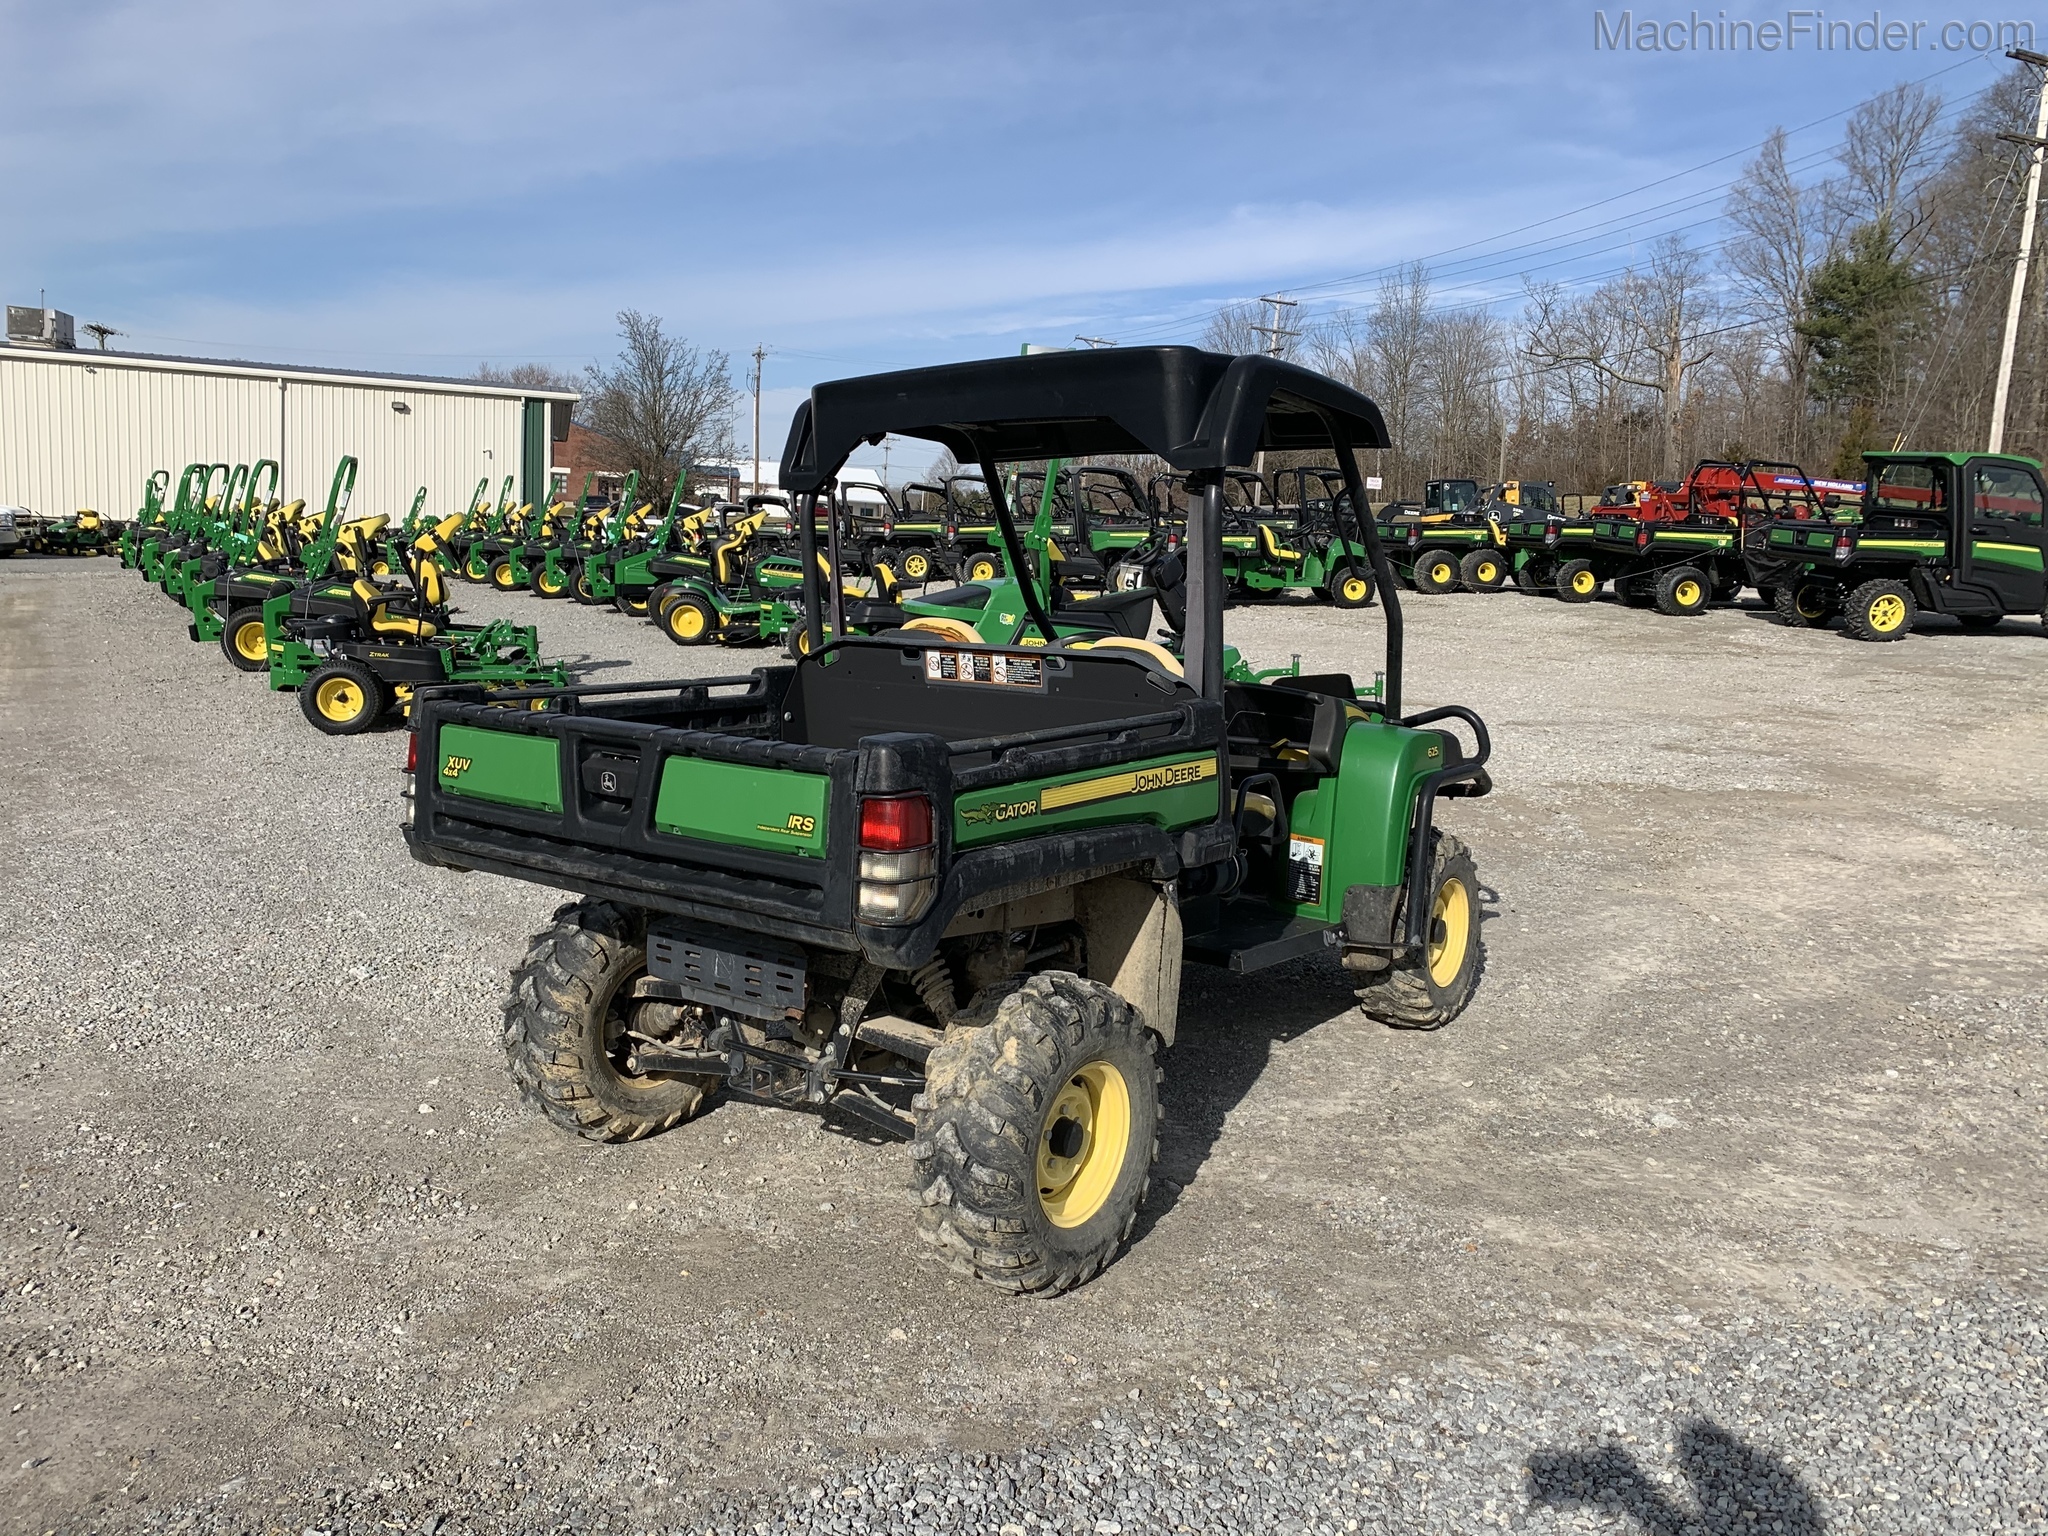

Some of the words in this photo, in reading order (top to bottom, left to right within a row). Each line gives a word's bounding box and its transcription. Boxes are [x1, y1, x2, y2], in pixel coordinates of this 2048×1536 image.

[1427, 746, 1439, 757] 625
[447, 755, 471, 771] XUV
[443, 767, 459, 778] 4x4
[1131, 771, 1163, 793] JOHN
[1164, 765, 1201, 787] DEERE
[995, 800, 1037, 820] GATOR
[787, 814, 815, 832] IRS
